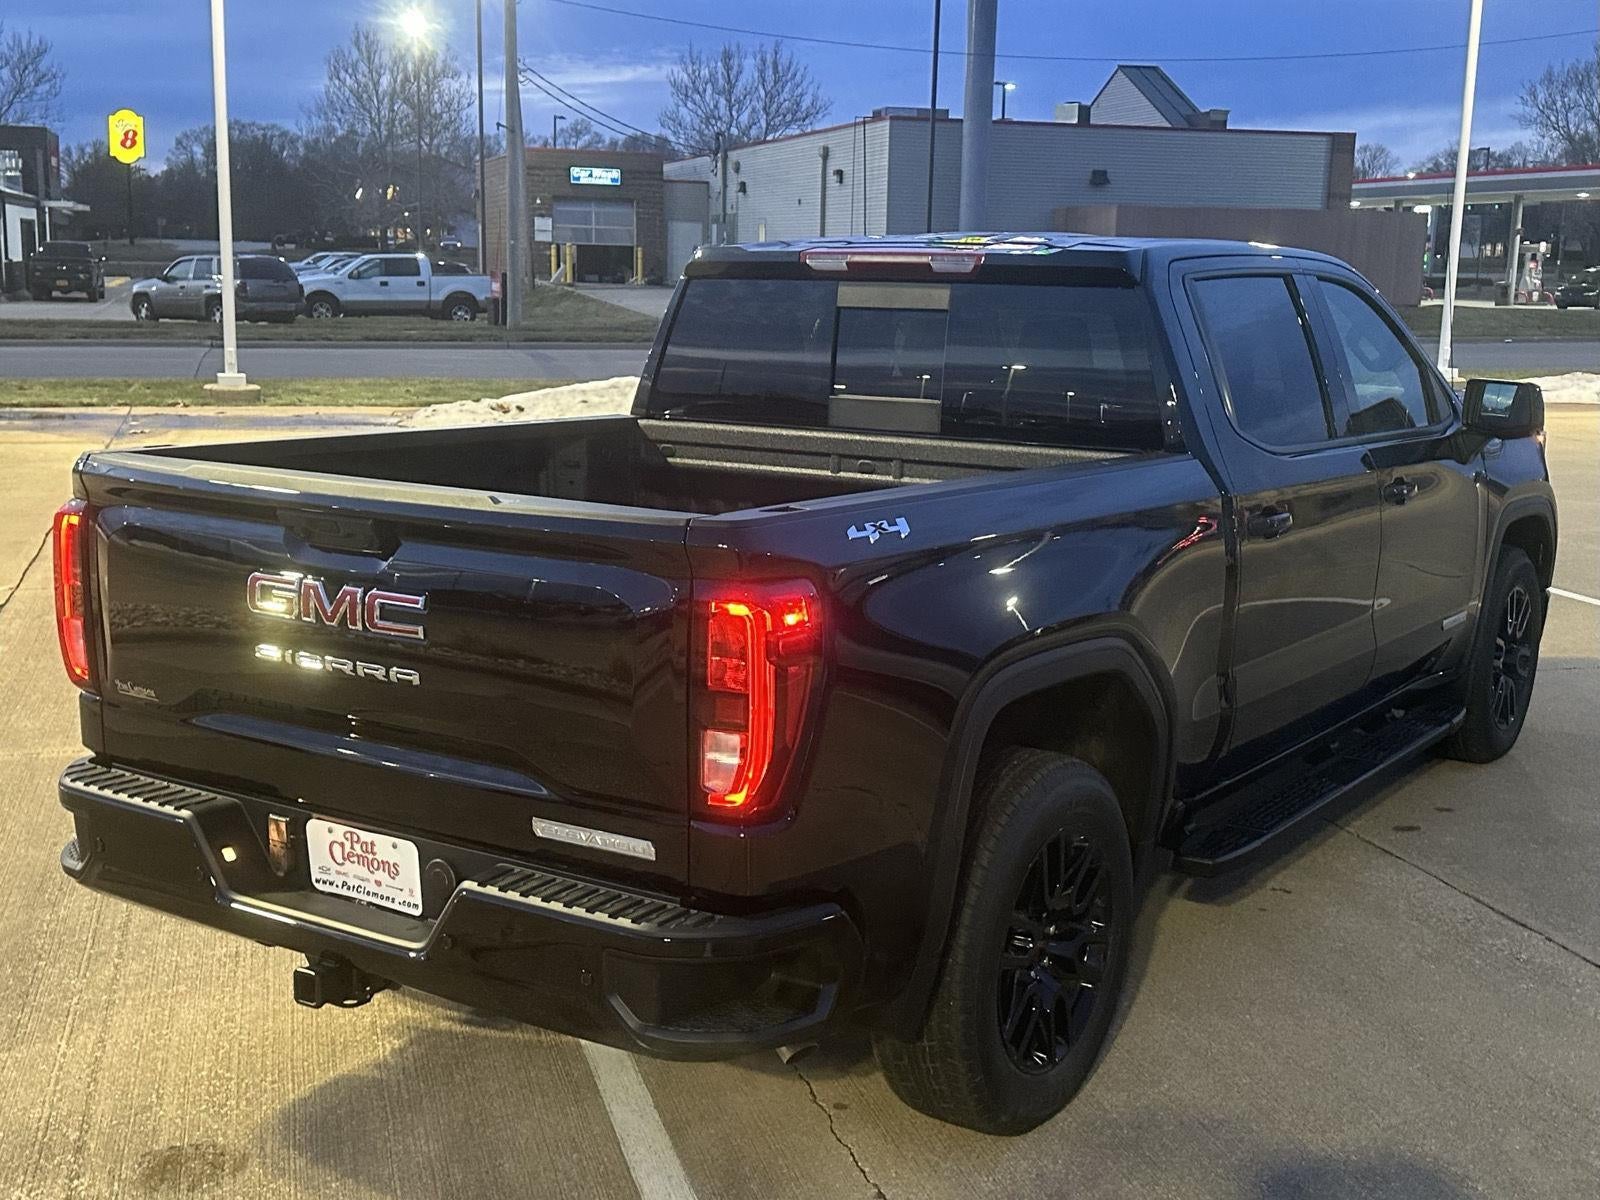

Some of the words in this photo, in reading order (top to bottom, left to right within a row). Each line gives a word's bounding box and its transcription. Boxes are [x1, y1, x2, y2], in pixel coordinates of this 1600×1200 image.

[120, 129, 138, 149] 8
[247, 571, 428, 640] GMC
[255, 643, 421, 686] SIERRA
[328, 840, 400, 880] Clemons
[343, 830, 377, 856] Pat
